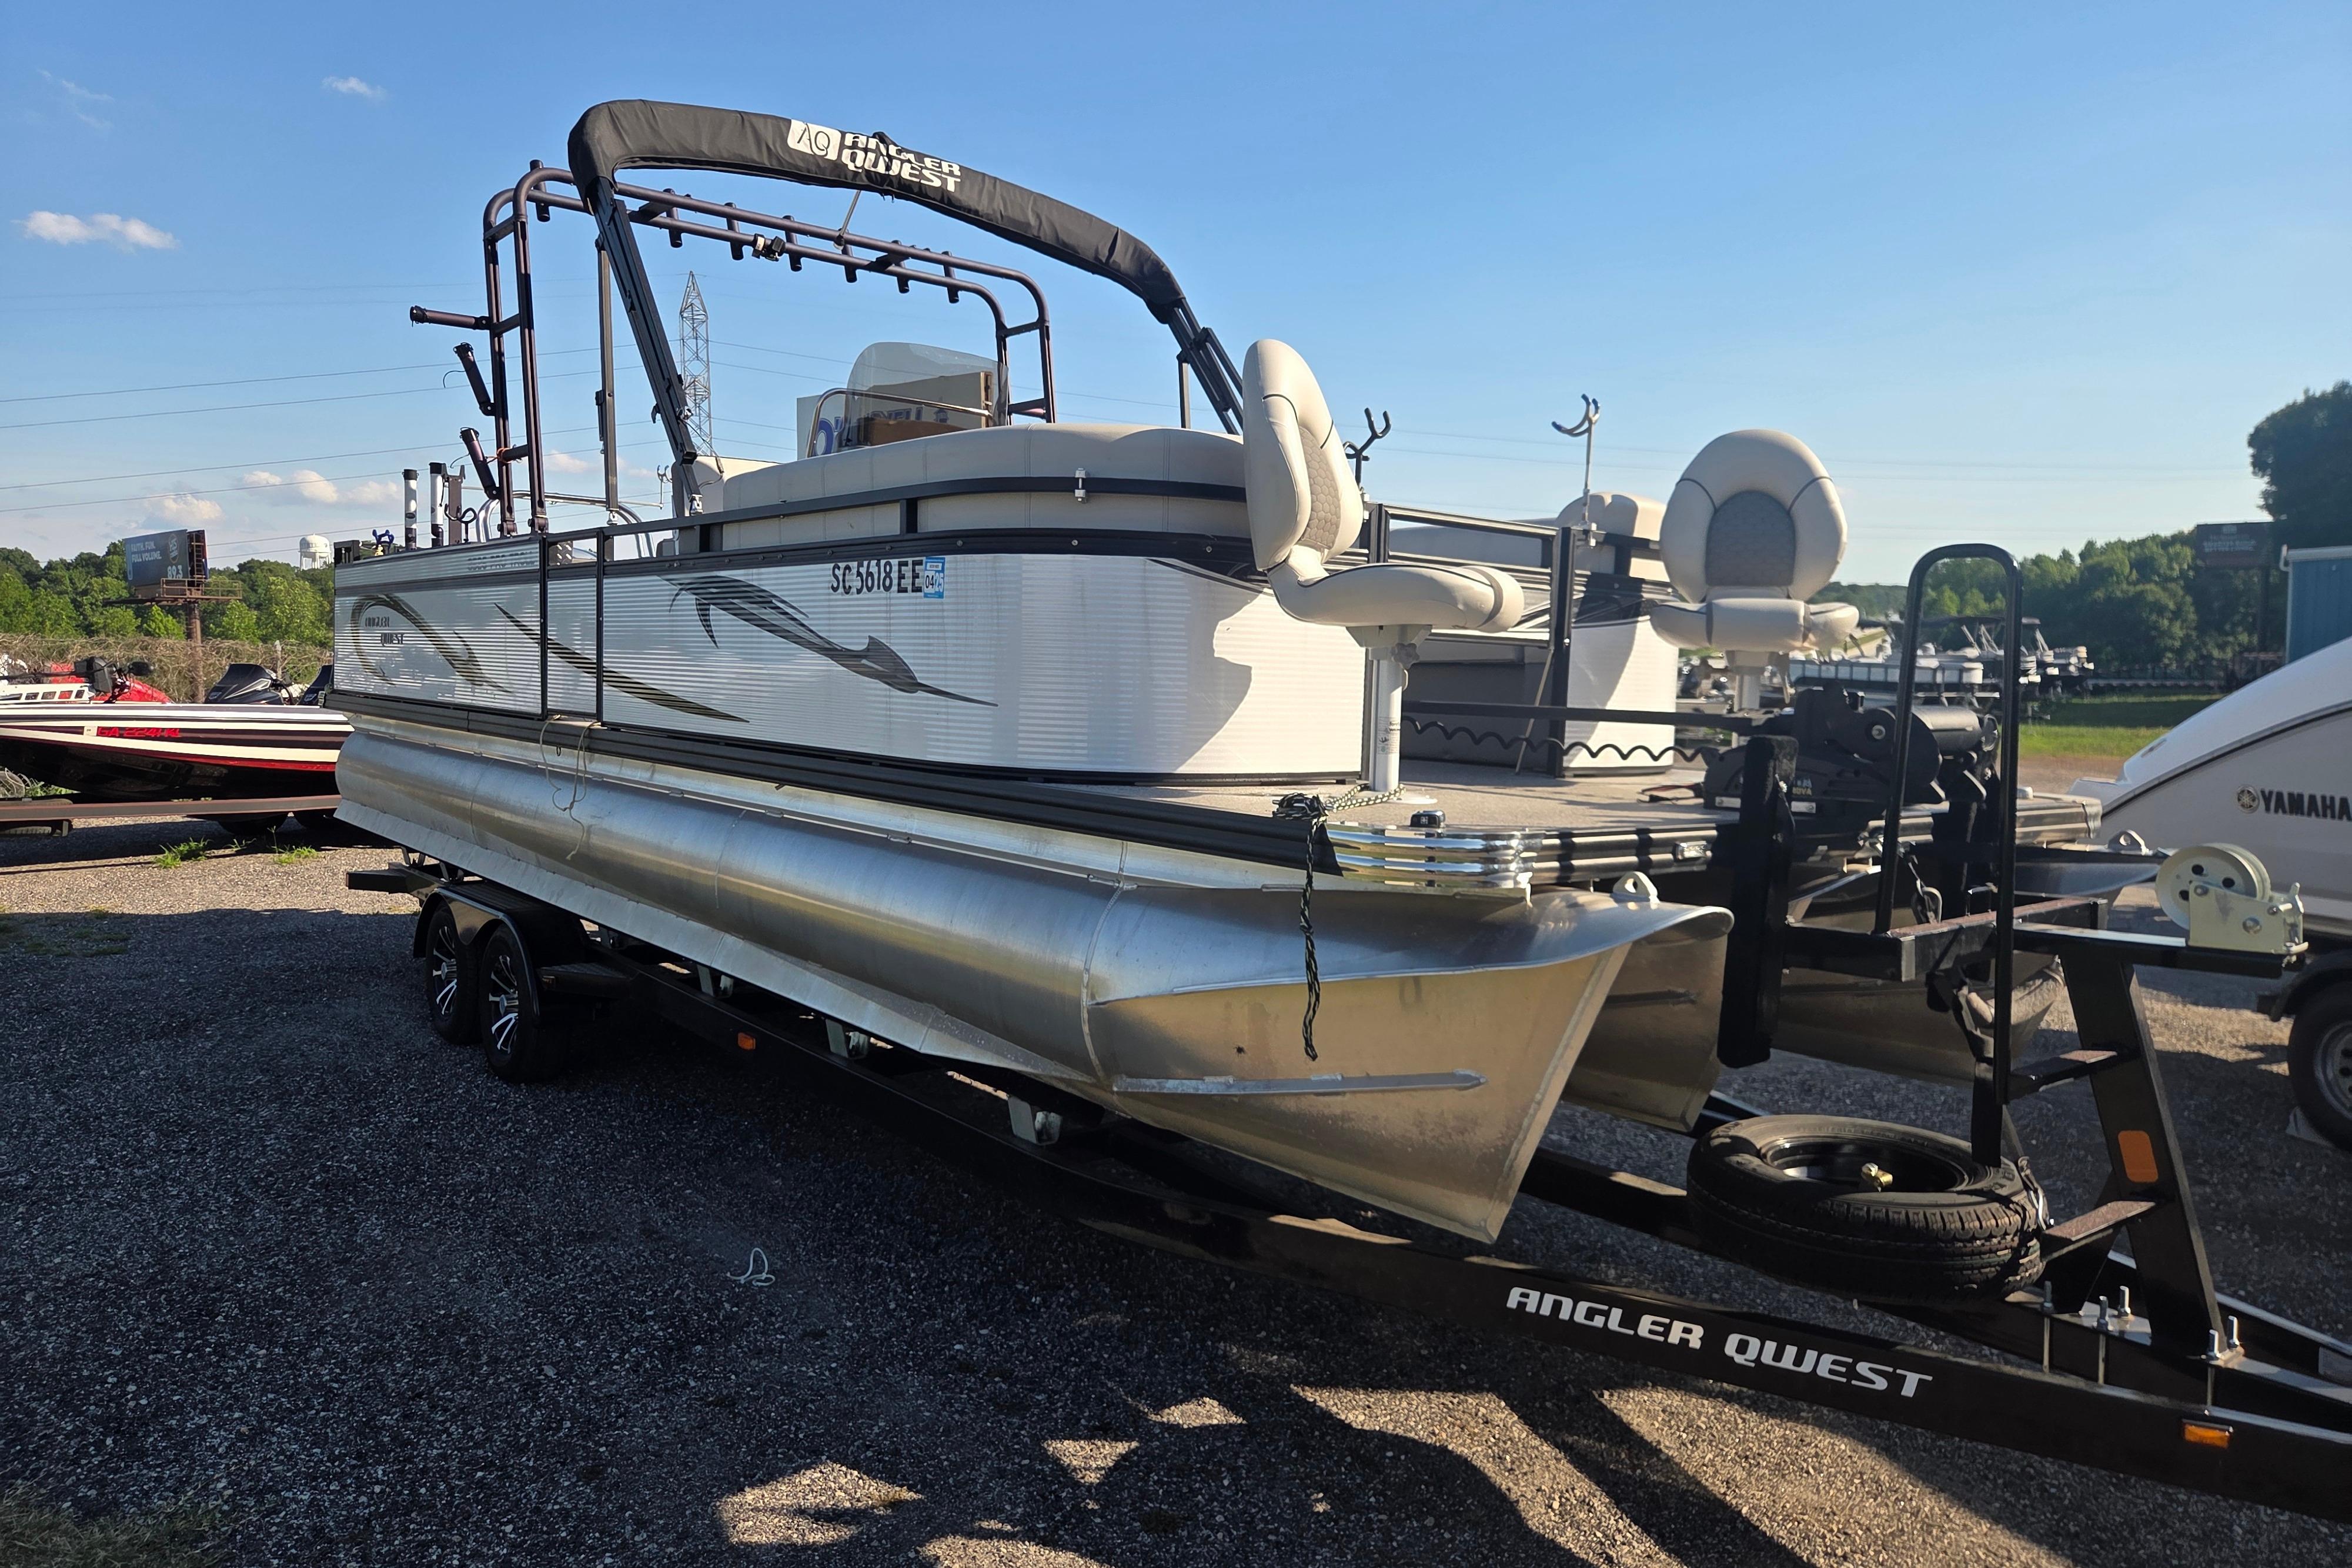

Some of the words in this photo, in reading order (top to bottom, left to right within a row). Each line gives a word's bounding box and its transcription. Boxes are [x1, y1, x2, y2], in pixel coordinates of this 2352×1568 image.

[841, 149, 961, 192] QWEST
[167, 564, 183, 579] 89.3
[831, 563, 852, 595] SC
[856, 559, 893, 595] 5618
[897, 559, 923, 593] EE
[926, 574, 934, 589] 04
[935, 572, 944, 593] 25
[98, 727, 119, 736] GA
[2260, 788, 2352, 821] YAMAHA
[1506, 1286, 1704, 1349] ANGLER
[1724, 1333, 1933, 1398] QWEST
